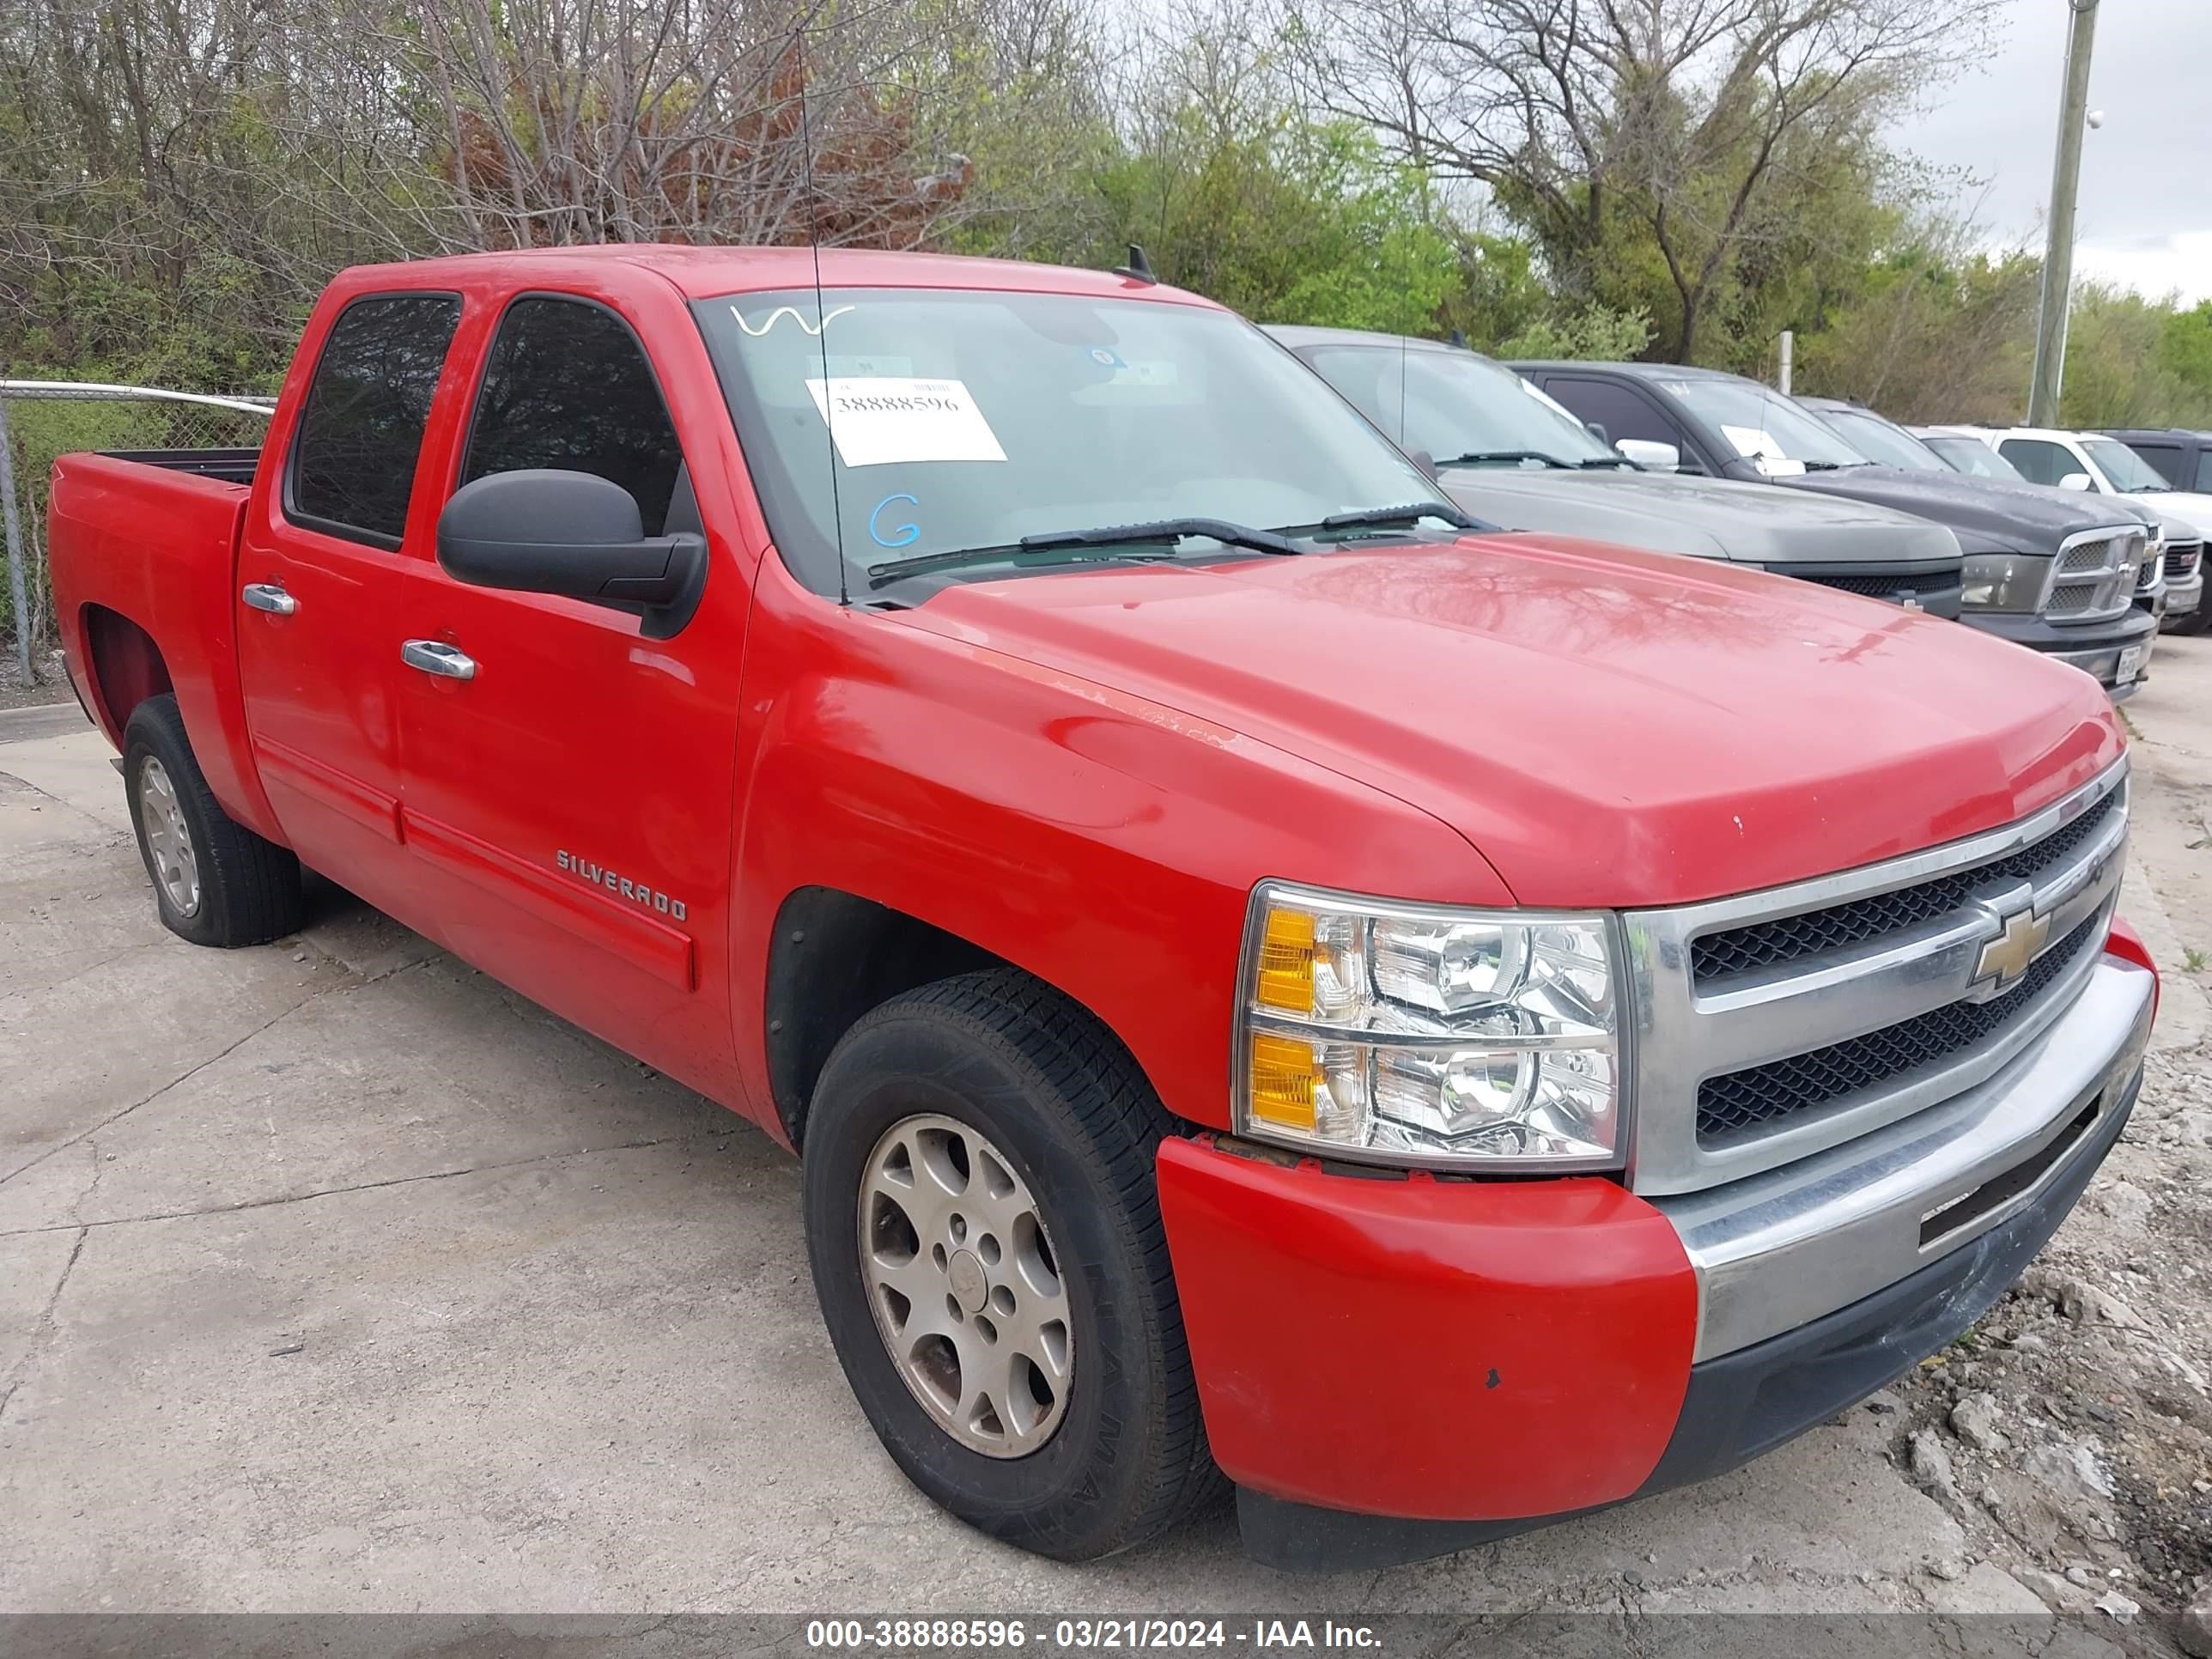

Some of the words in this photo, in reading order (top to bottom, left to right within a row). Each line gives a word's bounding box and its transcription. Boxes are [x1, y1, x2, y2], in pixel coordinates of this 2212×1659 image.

[836, 397, 960, 413] 38888596
[869, 494, 921, 548] G
[556, 849, 688, 922] SILVERADO
